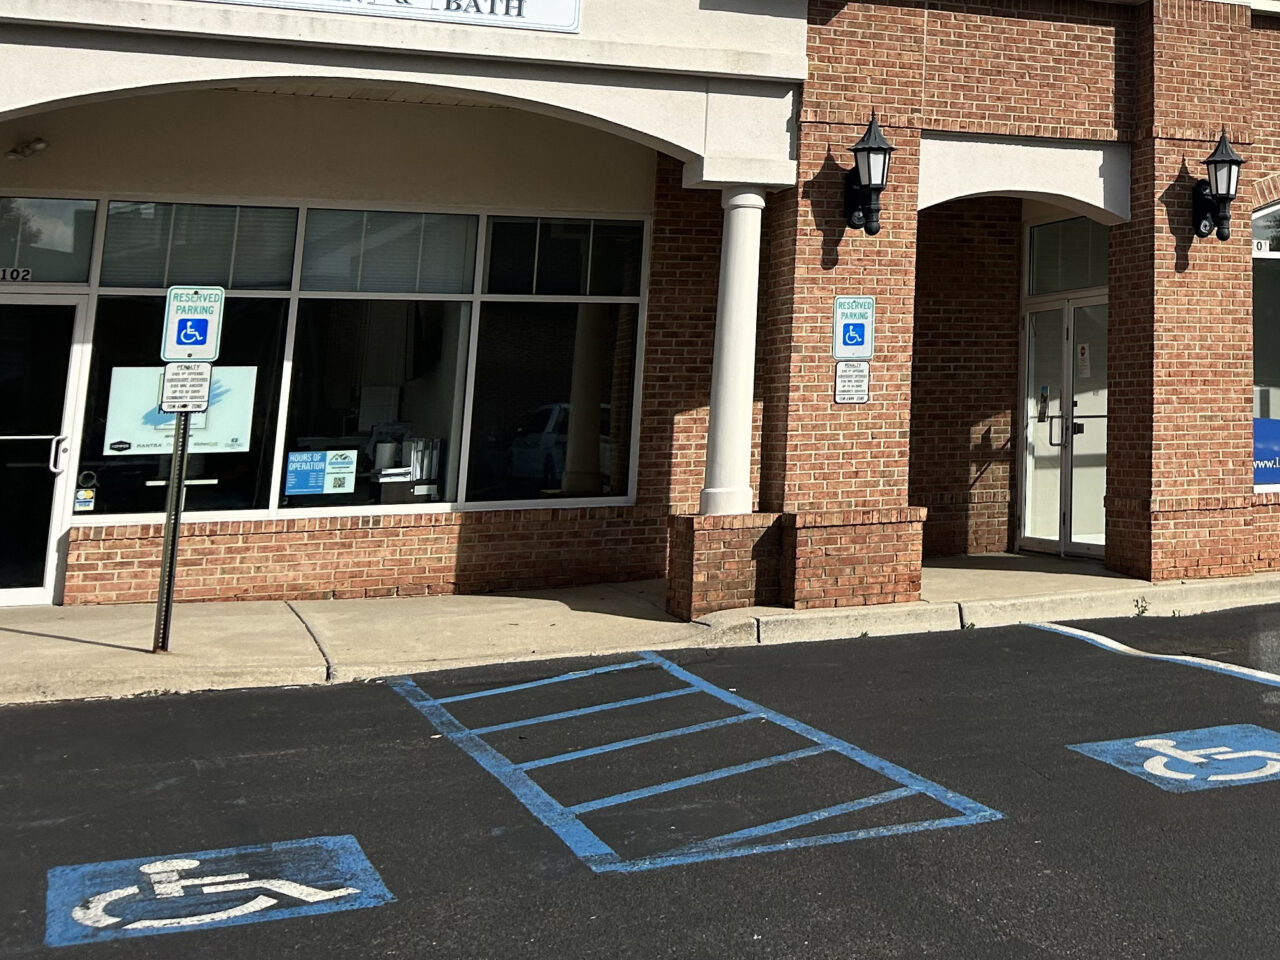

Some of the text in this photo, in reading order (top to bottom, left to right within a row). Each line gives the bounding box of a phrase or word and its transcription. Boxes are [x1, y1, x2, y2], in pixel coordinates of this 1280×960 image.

[1, 269, 30, 281] 102
[173, 292, 220, 303] RESERVED
[175, 305, 214, 315] PARKING
[838, 301, 872, 310] RESERVED
[841, 312, 868, 320] PARKING
[289, 453, 322, 462] HOURS OF
[289, 461, 325, 471] OPERATION
